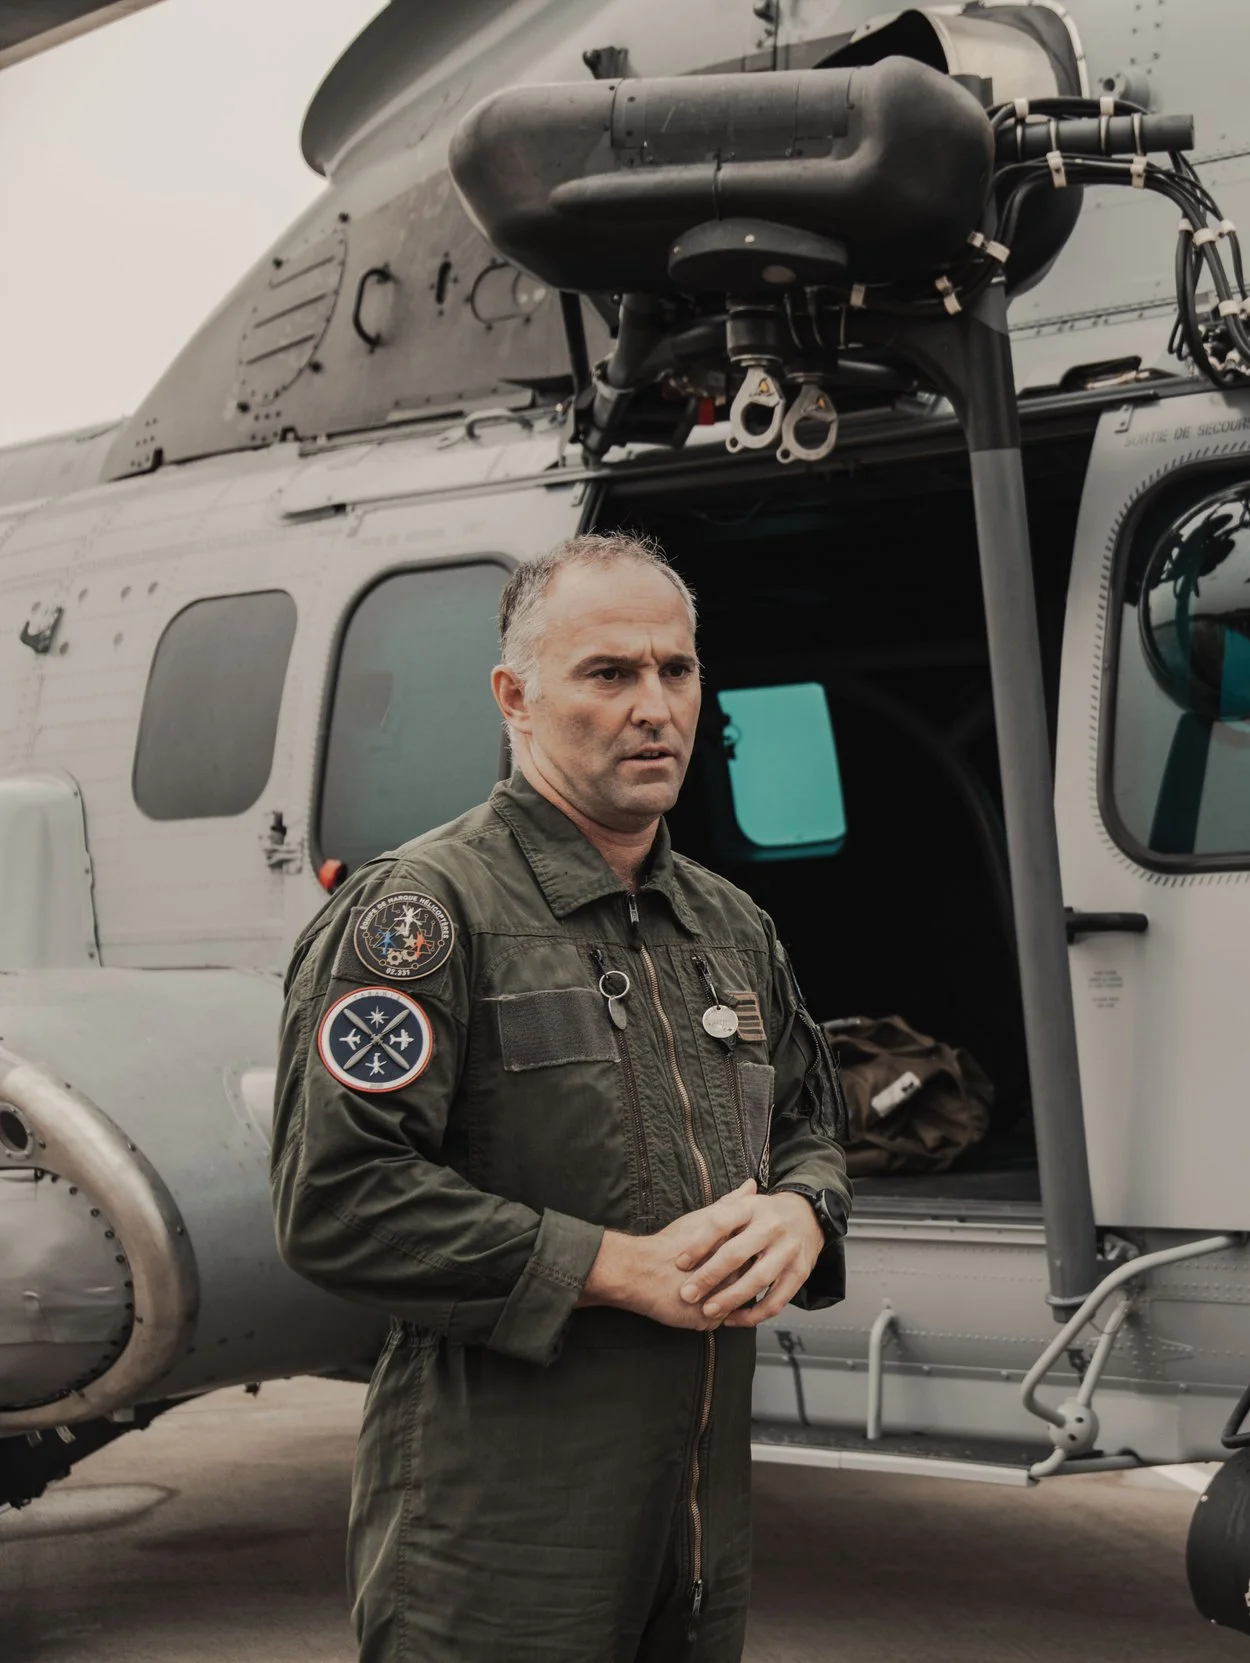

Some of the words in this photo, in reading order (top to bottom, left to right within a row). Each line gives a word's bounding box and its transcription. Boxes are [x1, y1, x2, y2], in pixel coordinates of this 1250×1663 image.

[1174, 426, 1191, 440] DE
[377, 900, 387, 910] DE
[388, 894, 418, 904] MARQUE
[419, 897, 450, 939] HÉLICOPTÈRES
[386, 967, 411, 976] 02.331
